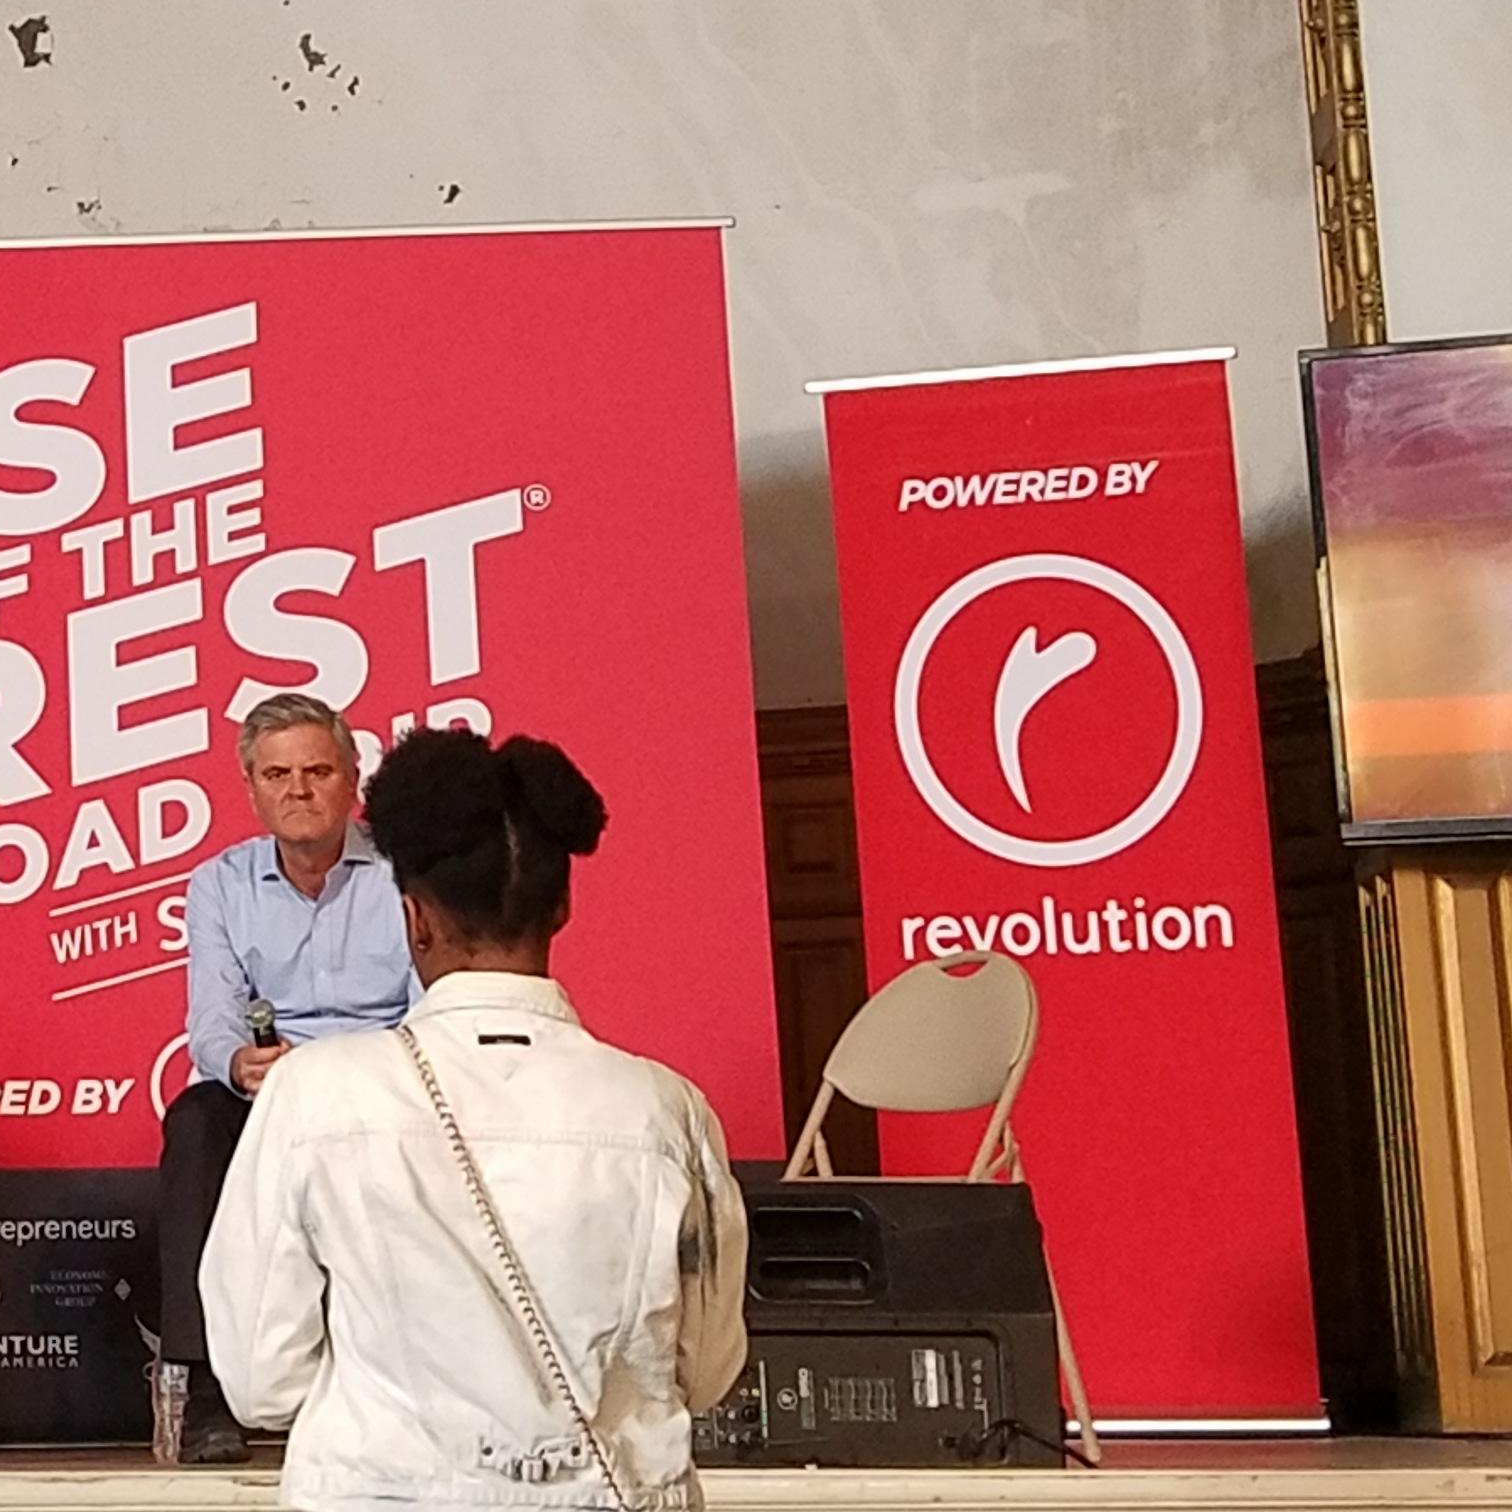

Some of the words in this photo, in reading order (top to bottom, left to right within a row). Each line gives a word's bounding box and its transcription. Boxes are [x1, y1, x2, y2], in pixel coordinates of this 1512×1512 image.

[898, 465, 1098, 512] POWERED
[1103, 460, 1160, 498] BY
[61, 479, 267, 601] THE
[50, 911, 138, 964] WITH
[900, 895, 1235, 961] revolution
[71, 1078, 136, 1115] BY
[0, 1355, 80, 1369] AMERICA
